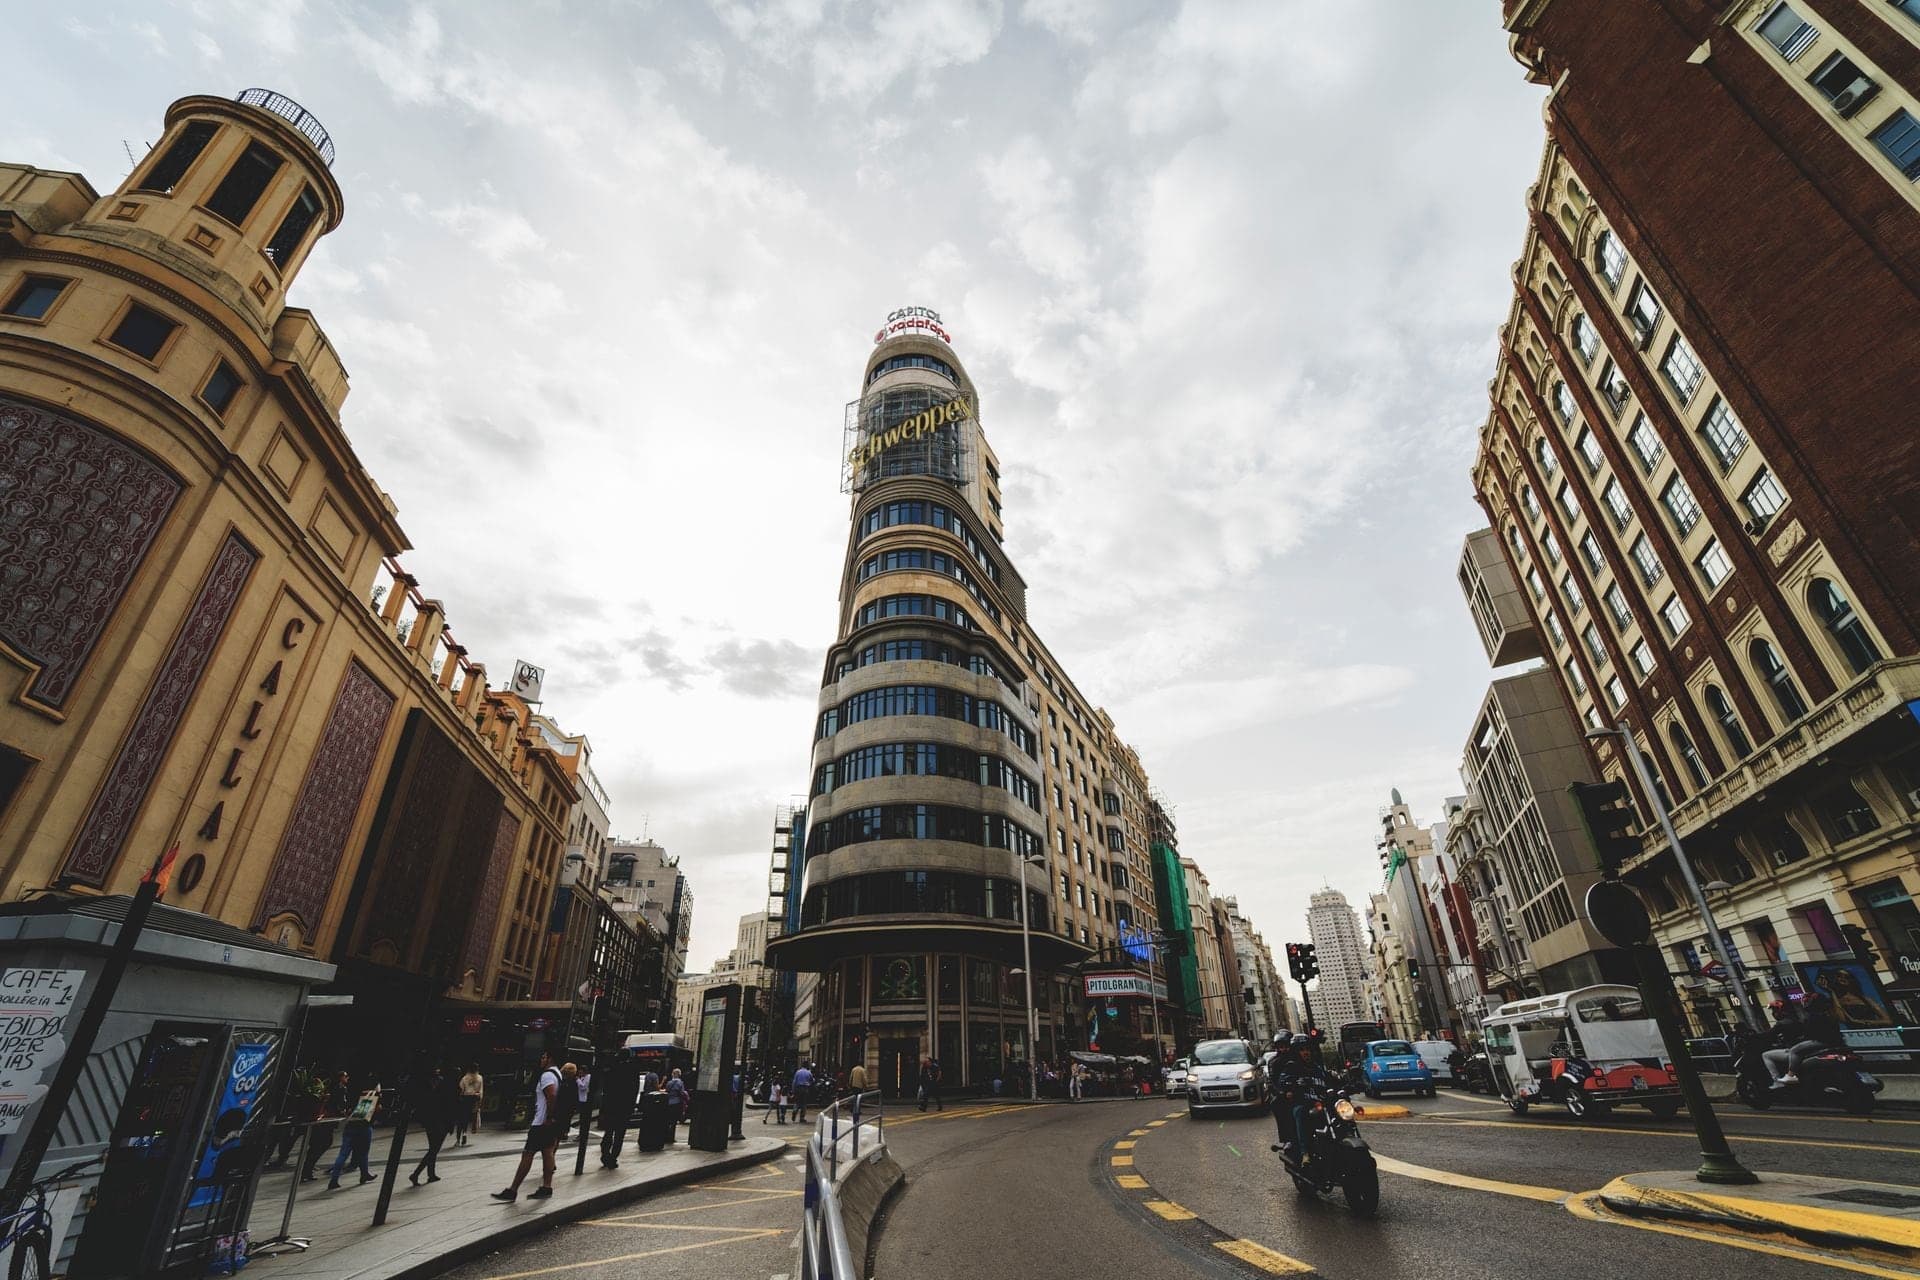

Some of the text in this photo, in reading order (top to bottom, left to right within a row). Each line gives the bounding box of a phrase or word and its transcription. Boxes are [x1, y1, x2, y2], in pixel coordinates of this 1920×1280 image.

[887, 305, 943, 325] CAPITOL
[888, 317, 951, 344] vodafone
[848, 396, 972, 472] Schweppes
[177, 617, 305, 895] CALLAO
[235, 1075, 259, 1093] GO!
